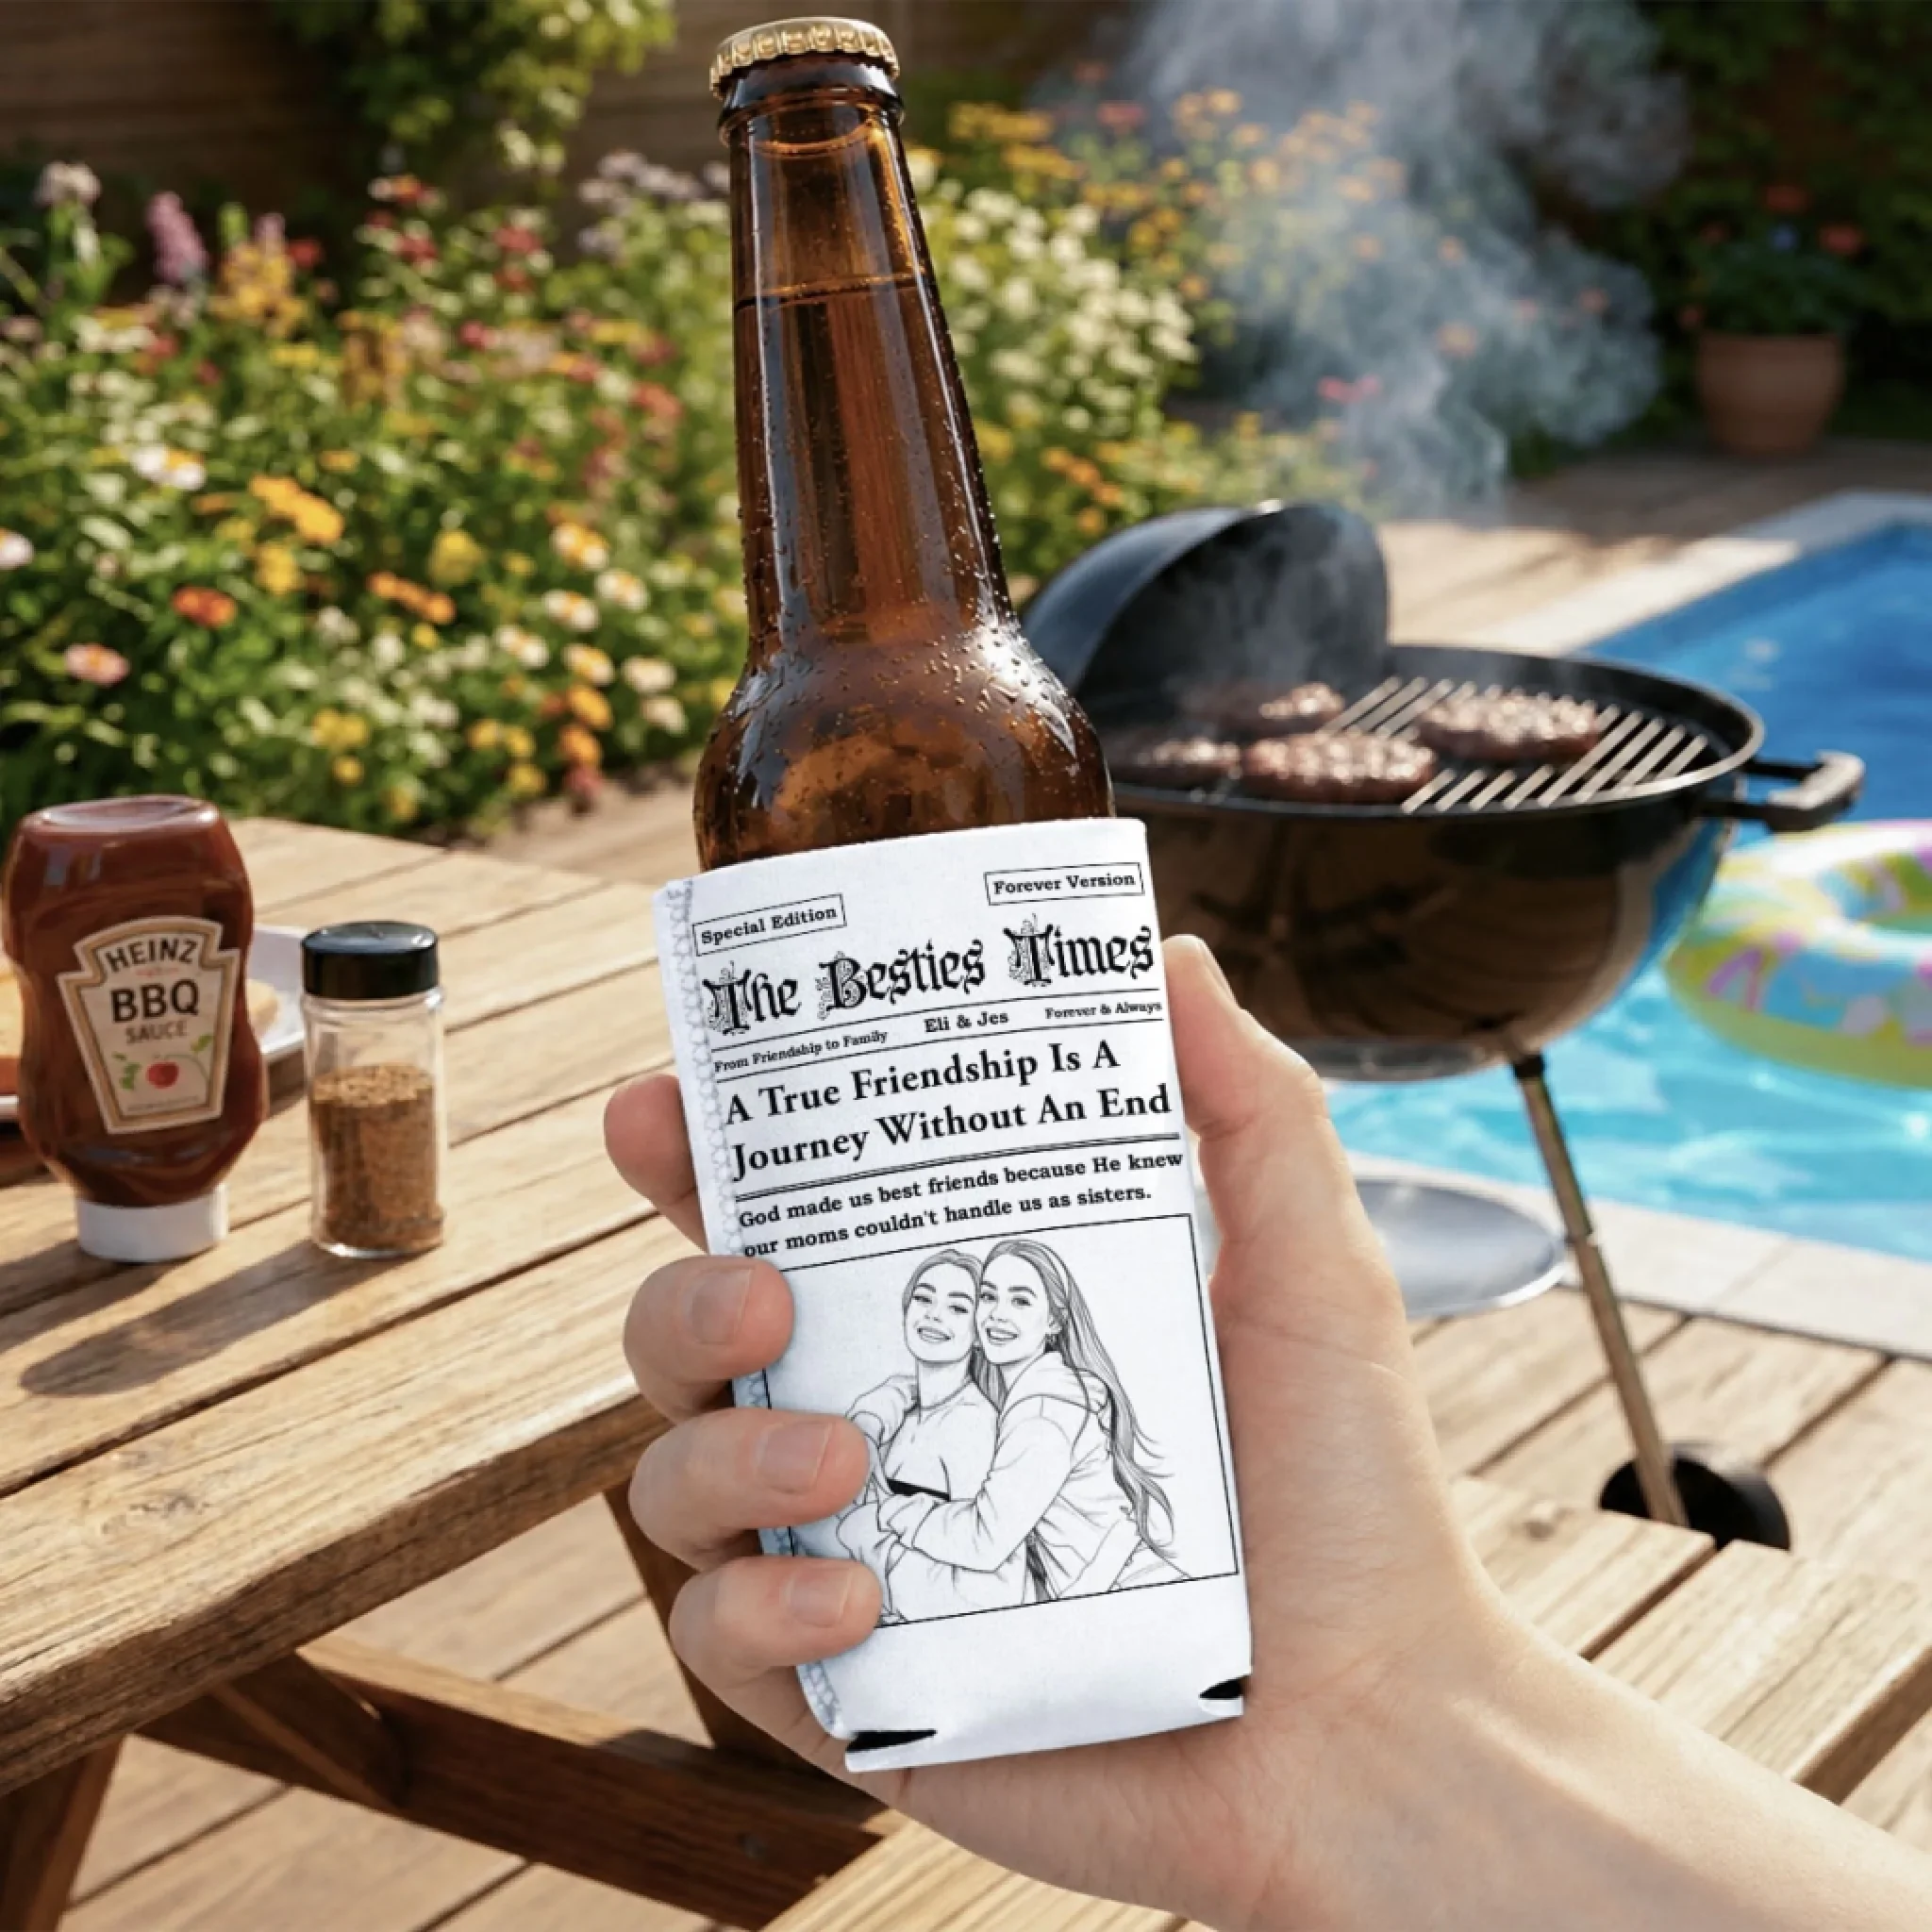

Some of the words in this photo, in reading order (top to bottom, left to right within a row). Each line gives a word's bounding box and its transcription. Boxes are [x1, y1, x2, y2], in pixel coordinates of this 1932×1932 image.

[993, 879, 1062, 894] Forever
[1066, 872, 1137, 889] Version
[701, 918, 766, 945] Special
[771, 907, 838, 929] Edition
[106, 938, 197, 973] HEINZ
[702, 960, 802, 1036] The
[815, 938, 985, 1020] Besties
[1002, 912, 1154, 987] Times
[110, 978, 200, 1024] BBQ
[924, 1016, 950, 1033] Eli
[956, 1014, 972, 1029] &
[977, 1011, 1009, 1026] Jes
[1044, 1006, 1096, 1019] Forever
[1099, 1003, 1112, 1015] &
[1115, 1001, 1162, 1015] Always
[125, 1021, 188, 1044] SAUCE
[714, 1058, 750, 1073] From
[752, 1041, 823, 1065] Friendship
[825, 1039, 841, 1050] to
[842, 1030, 888, 1048] Family
[726, 1093, 754, 1124] A
[758, 1084, 841, 1117] True
[850, 1049, 1038, 1101] Friendship
[1048, 1042, 1081, 1072] Is
[1091, 1040, 1121, 1069] A
[732, 1130, 870, 1182] Journey
[874, 1104, 1026, 1145] Without
[1038, 1094, 1087, 1124] An
[1096, 1083, 1172, 1118] End
[740, 1204, 781, 1227] God
[787, 1195, 843, 1219] made
[849, 1192, 874, 1208] us
[877, 1181, 922, 1203] best
[928, 1170, 998, 1195] friends
[1003, 1162, 1086, 1183] because
[1092, 1157, 1121, 1173] He
[1127, 1154, 1183, 1171] knew
[744, 1240, 778, 1257] our
[785, 1227, 849, 1249] moms
[854, 1210, 939, 1238] couldn't
[943, 1198, 1012, 1223] handle
[1019, 1197, 1042, 1212] us
[1048, 1194, 1072, 1208] as
[1077, 1187, 1152, 1206] sisters.
